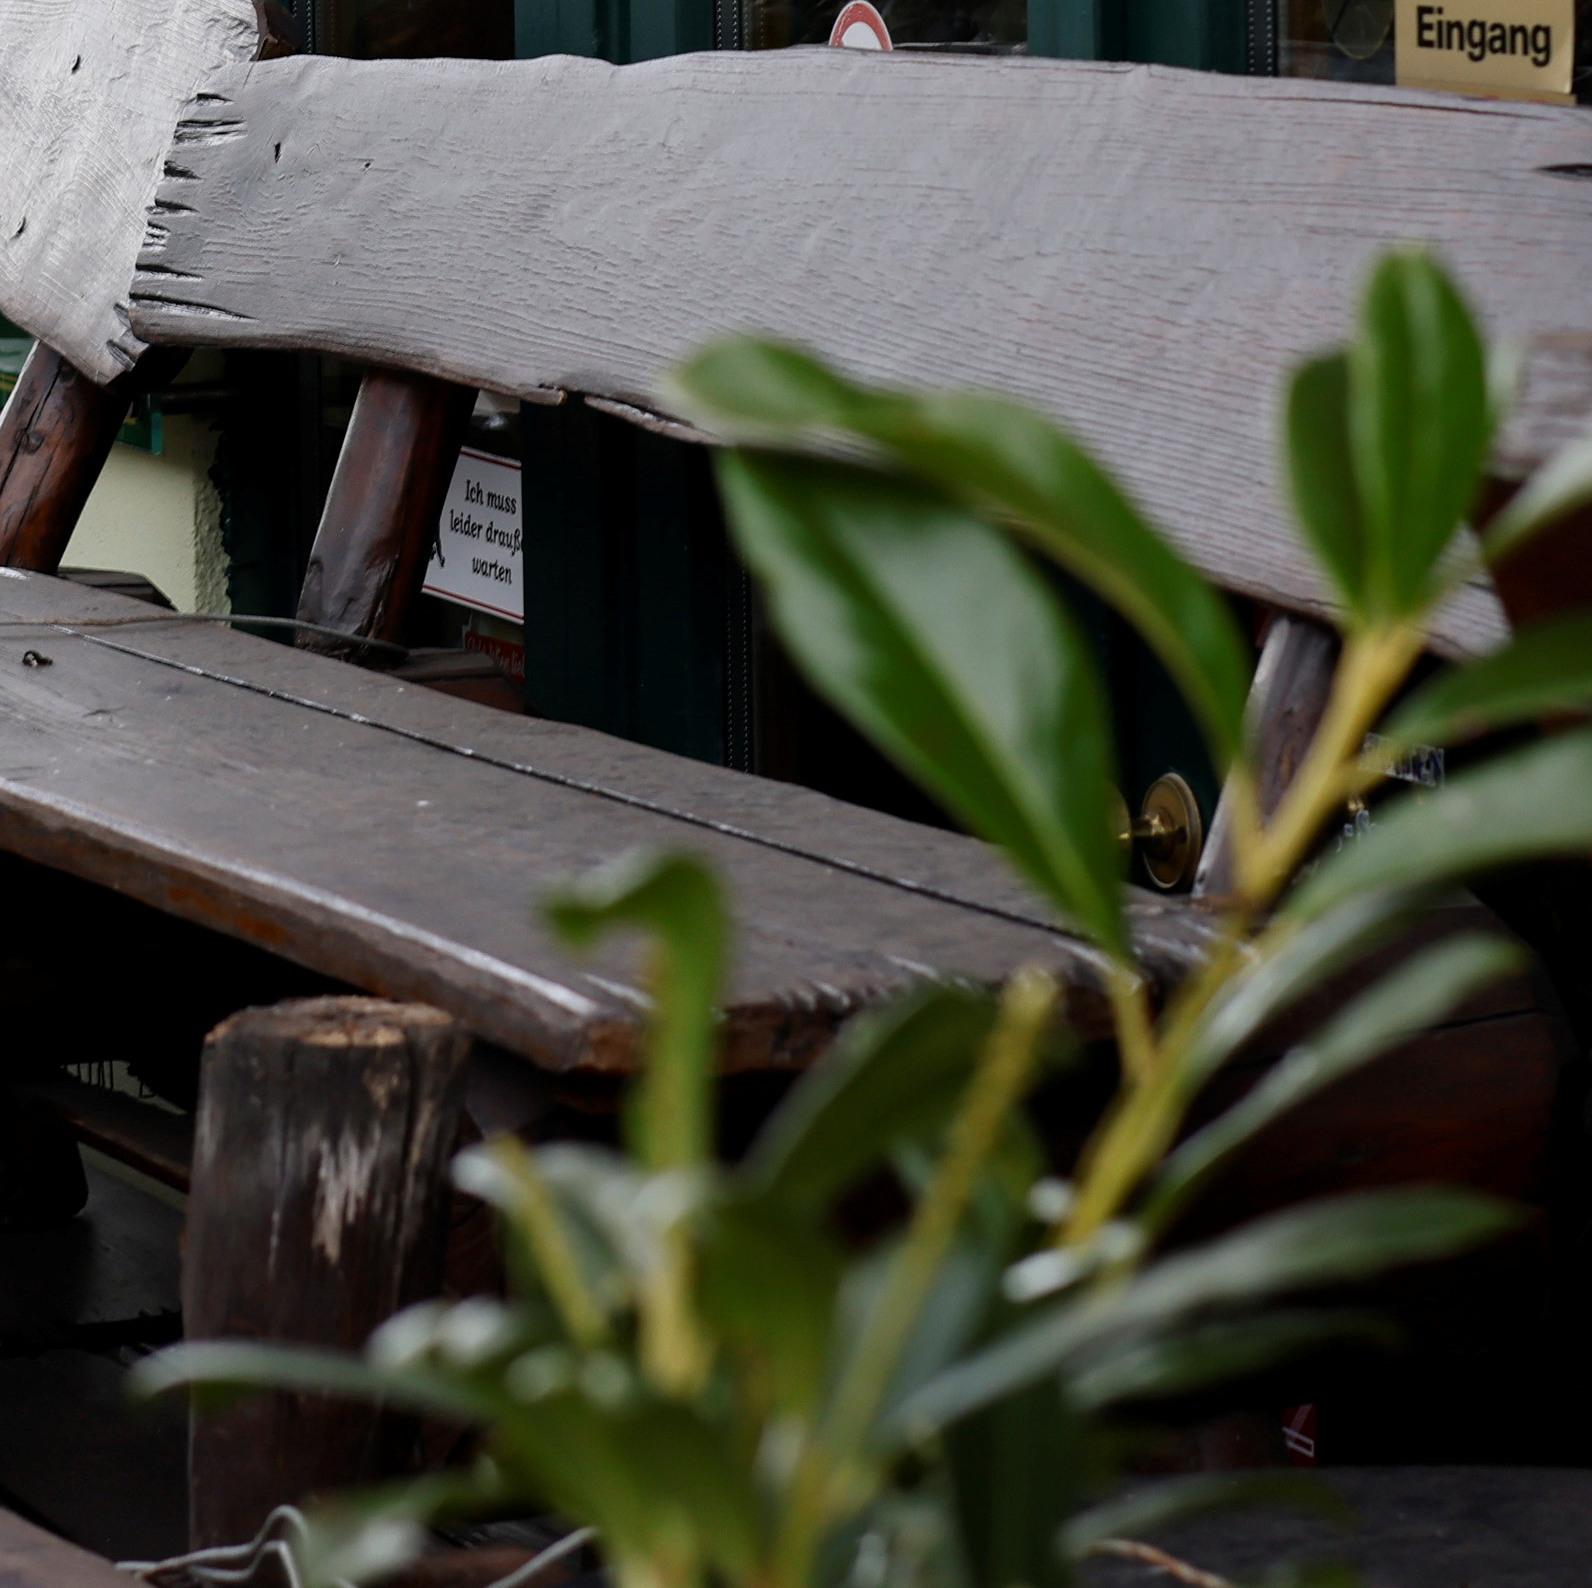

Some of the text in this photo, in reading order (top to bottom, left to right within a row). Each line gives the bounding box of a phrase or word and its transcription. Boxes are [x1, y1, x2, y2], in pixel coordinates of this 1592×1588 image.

[1416, 4, 1551, 68] Eingang
[464, 478, 517, 516] Ich muss
[449, 509, 522, 557] leider drauß
[471, 555, 513, 585] warten
